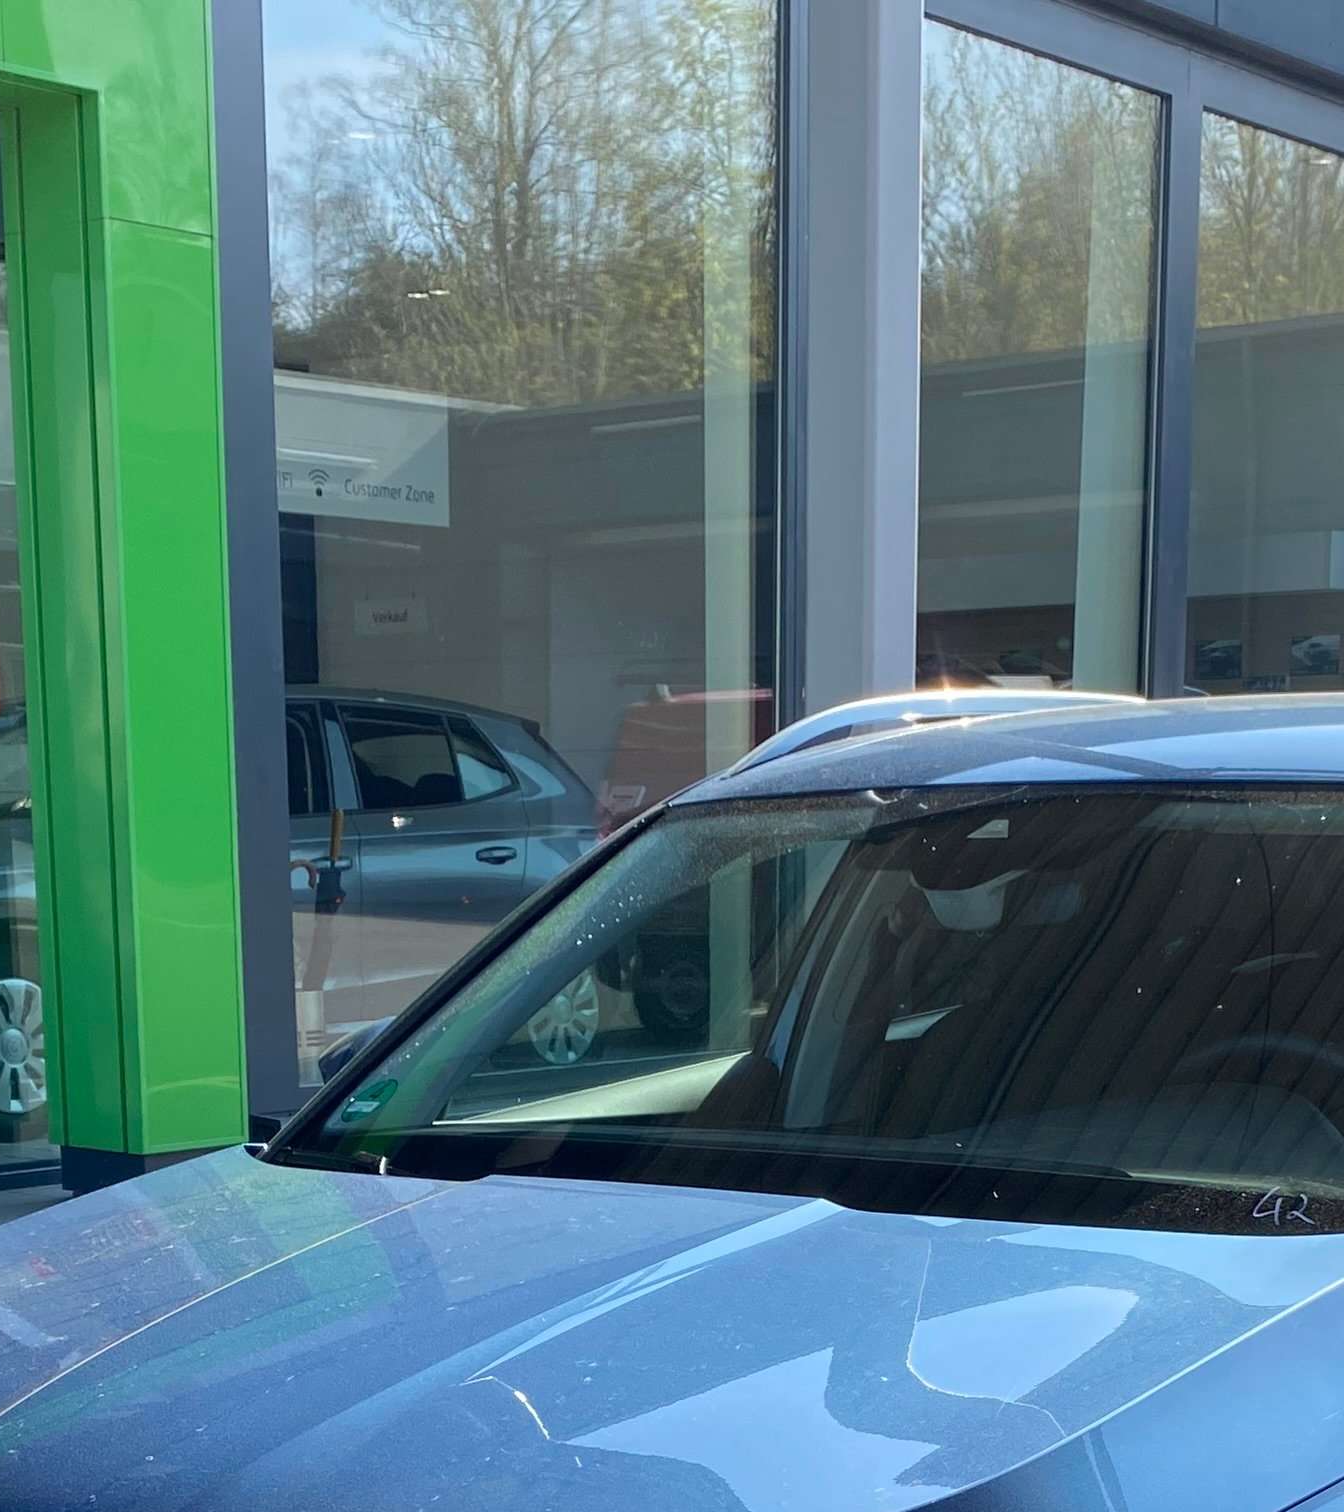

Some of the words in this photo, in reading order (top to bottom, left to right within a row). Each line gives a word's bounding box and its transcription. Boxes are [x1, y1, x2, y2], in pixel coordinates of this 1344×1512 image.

[343, 478, 402, 500] Customer
[405, 484, 435, 504] Zone
[1252, 1185, 1316, 1226] 42
